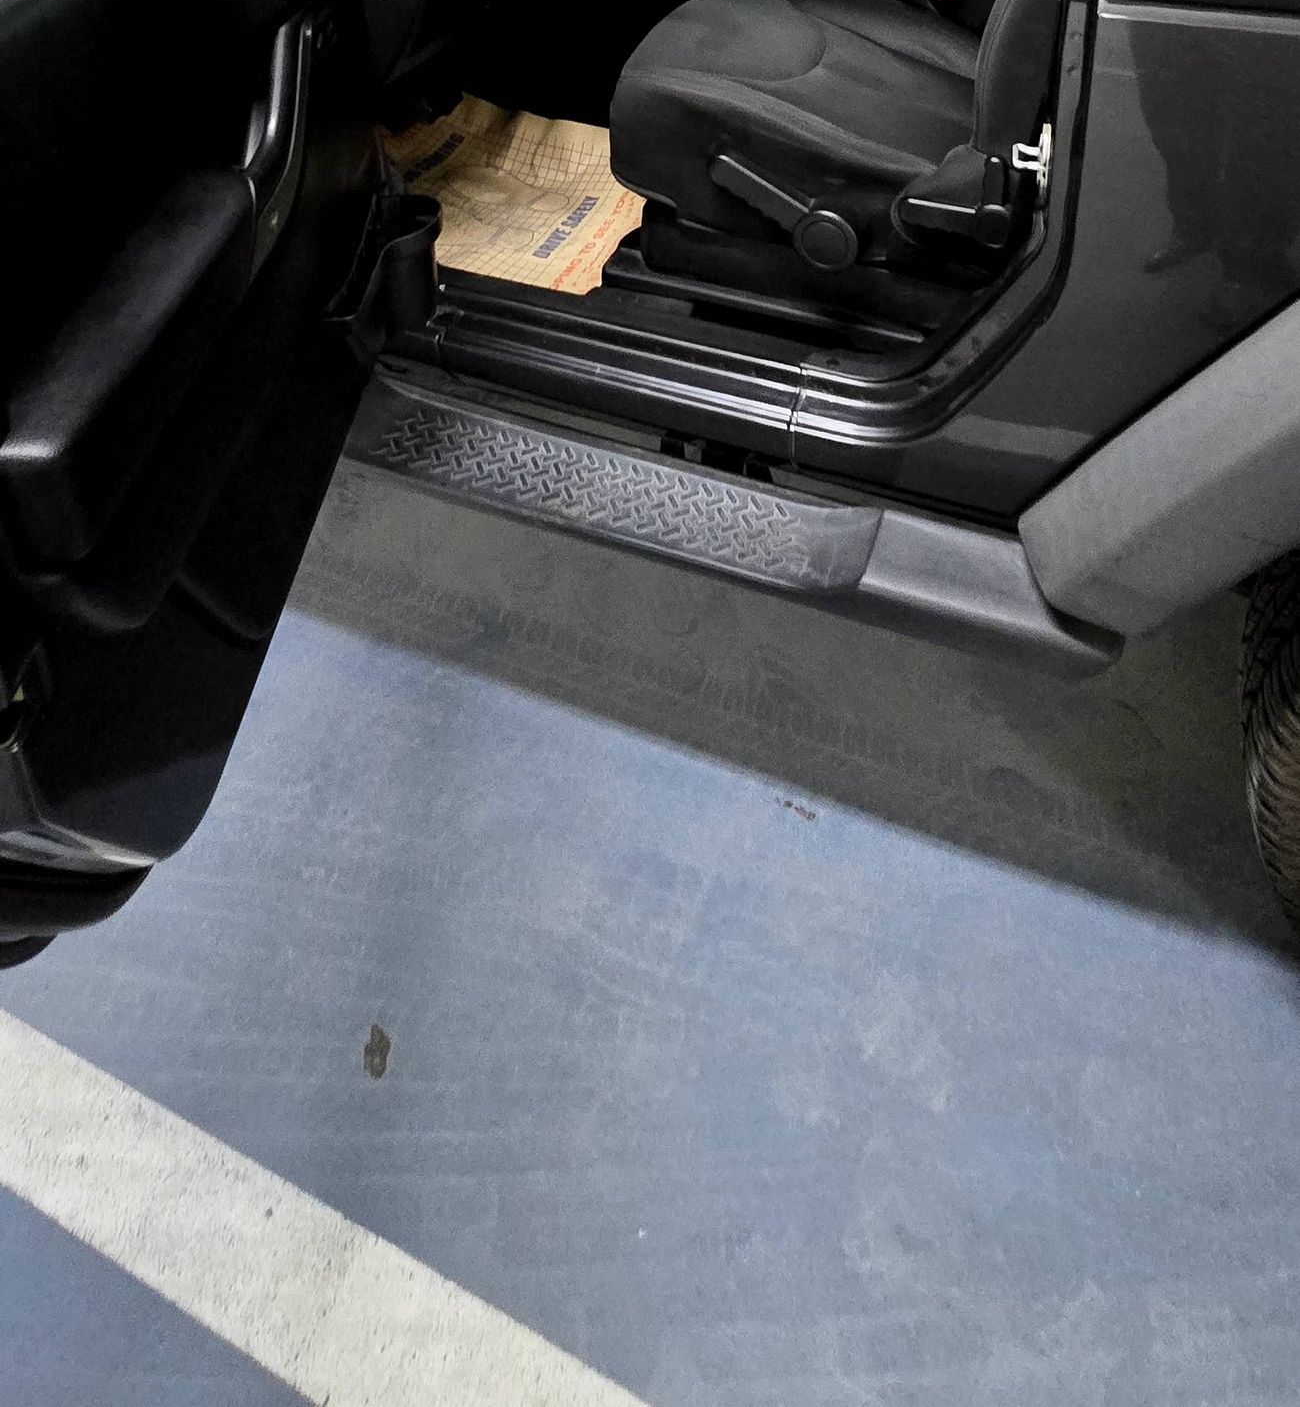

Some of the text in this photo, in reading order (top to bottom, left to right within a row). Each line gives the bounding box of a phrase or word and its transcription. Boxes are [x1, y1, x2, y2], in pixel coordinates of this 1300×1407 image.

[532, 227, 572, 259] DRIVE
[561, 195, 600, 229] SAFELY
[577, 241, 597, 257] TO
